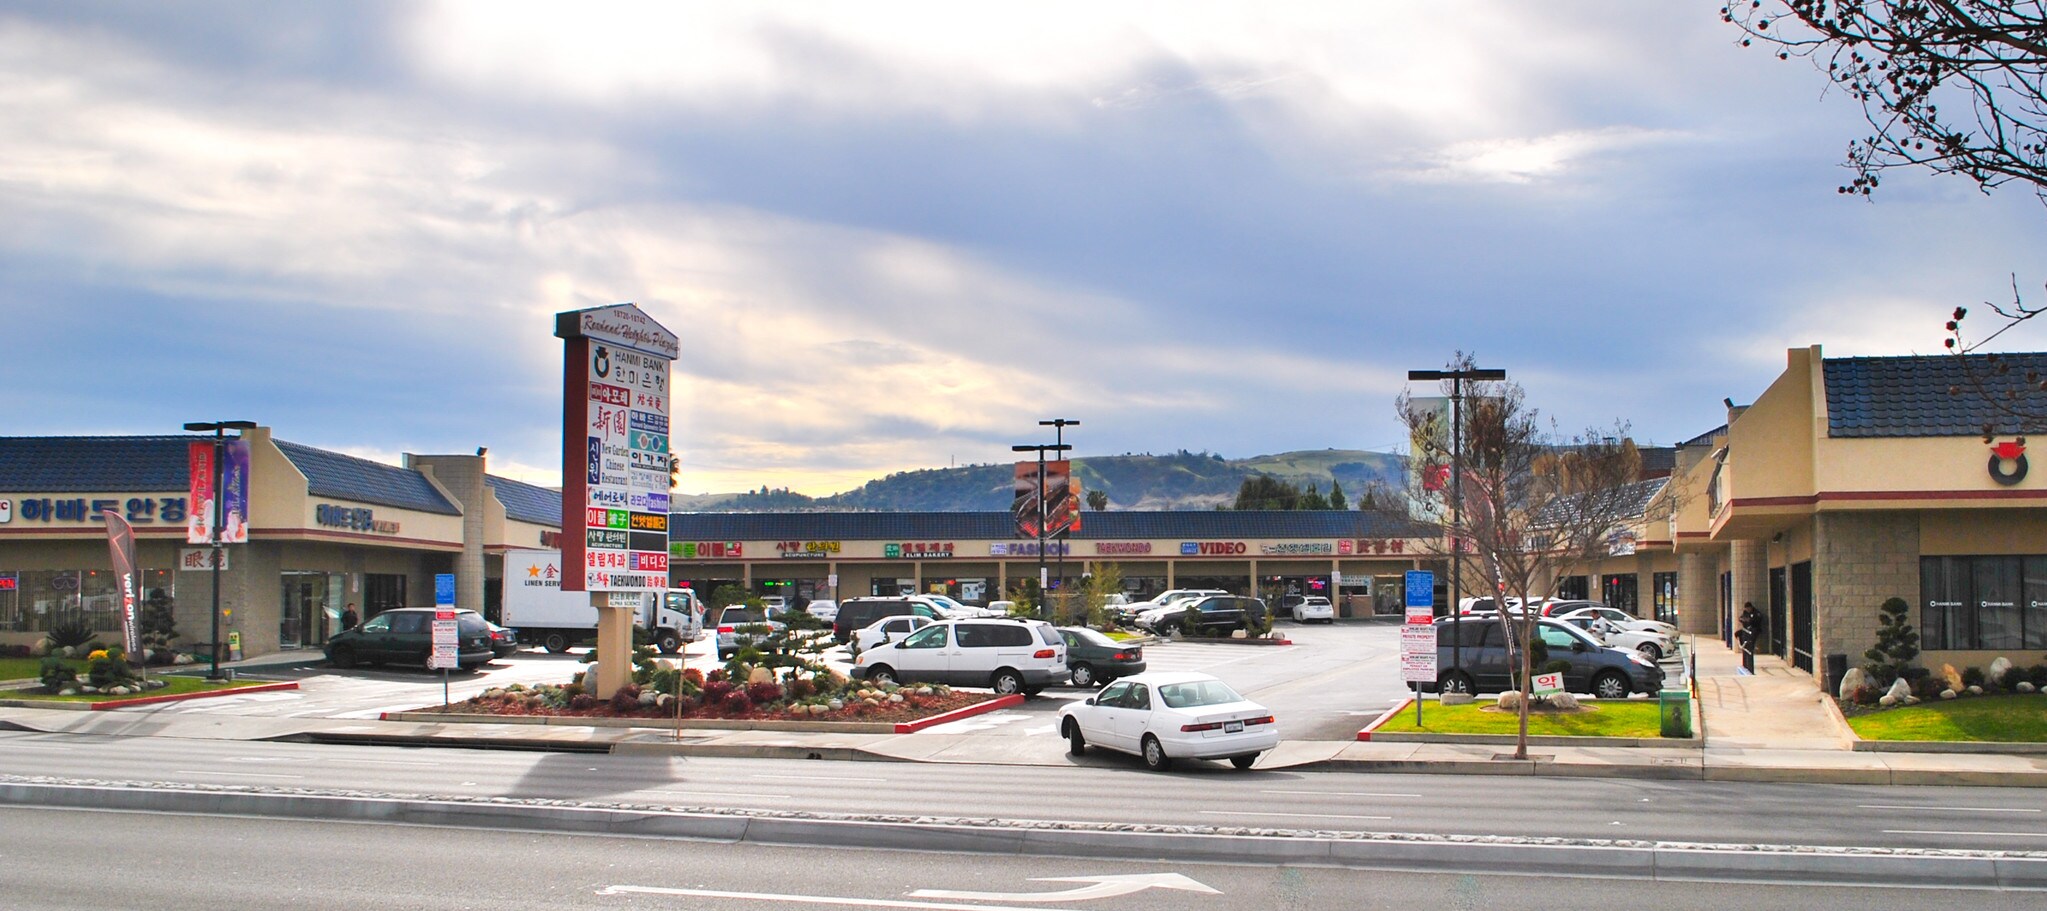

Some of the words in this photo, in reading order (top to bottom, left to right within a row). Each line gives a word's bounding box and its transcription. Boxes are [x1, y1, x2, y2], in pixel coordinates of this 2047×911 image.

[615, 351, 640, 366] HANMI
[643, 357, 664, 373] BANK
[615, 366, 665, 392] 한미은행
[602, 387, 628, 406] 아모레
[601, 443, 611, 455] New
[612, 445, 629, 457] Garden
[588, 442, 599, 482] 신원
[606, 459, 625, 471] Chinese
[631, 452, 668, 467] 이가자
[601, 473, 628, 485] Restaurant
[197, 452, 207, 526] ROWLAND
[593, 490, 628, 506] 에어로빅
[21, 498, 188, 523] 하바드안경
[587, 510, 607, 525] 이불
[606, 531, 626, 543] 한의원
[806, 541, 840, 552] 한의원
[1009, 543, 1070, 555] FASHION
[1095, 542, 1151, 554] TAEKWONDO
[1199, 542, 1247, 554] VIDEO
[640, 554, 667, 569] 비디오
[543, 563, 559, 578] 金
[610, 574, 646, 588] TAEKWONDO
[123, 572, 135, 620] verizon
[1538, 675, 1557, 689] 약
